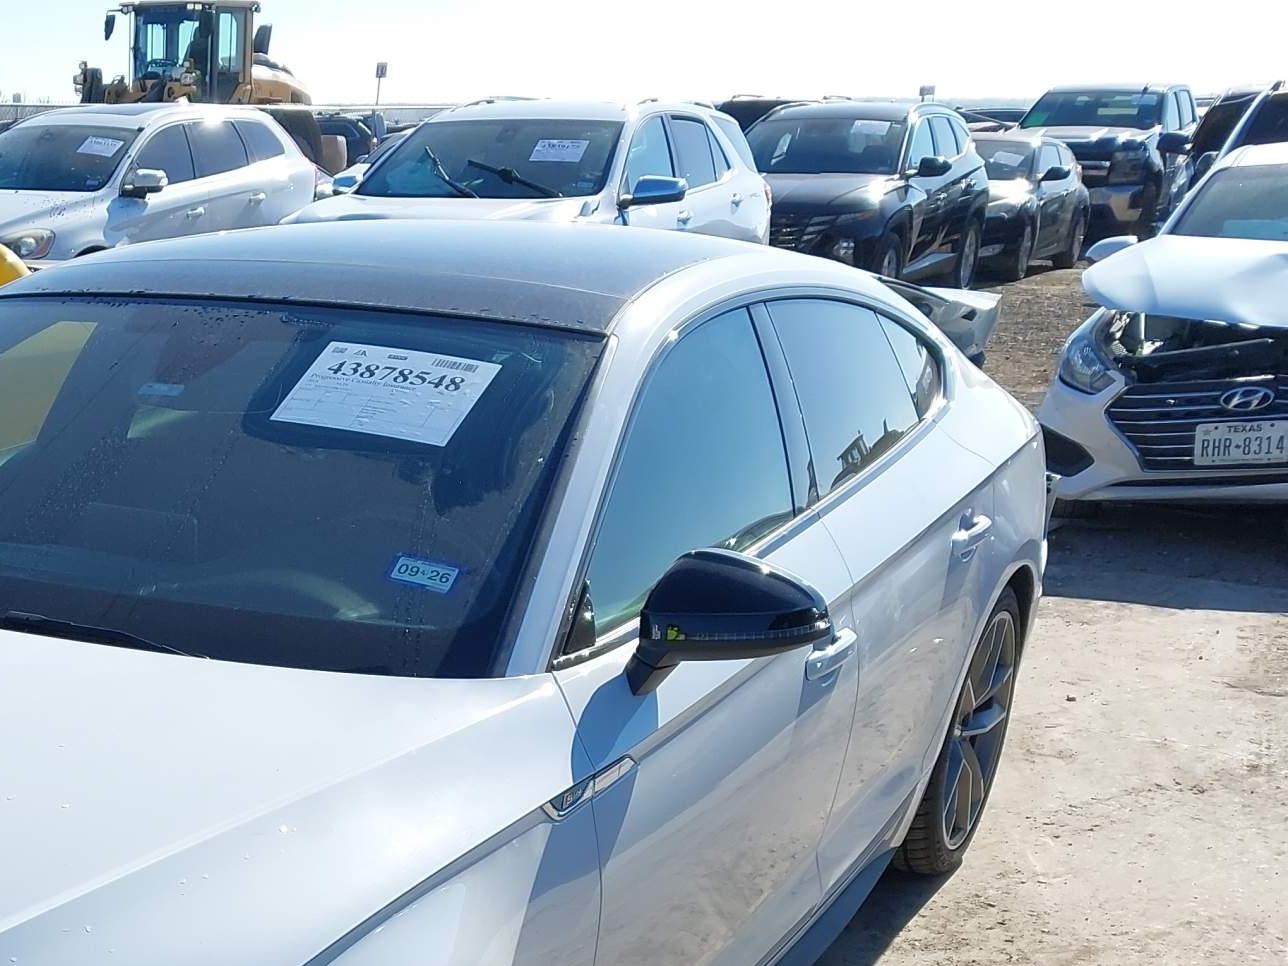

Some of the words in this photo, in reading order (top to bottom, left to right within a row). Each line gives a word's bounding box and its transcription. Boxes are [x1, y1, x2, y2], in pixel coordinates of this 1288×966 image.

[327, 360, 465, 391] 43878548
[1226, 423, 1263, 433] TEXAS
[397, 563, 420, 577] 09
[427, 569, 452, 584] 26
